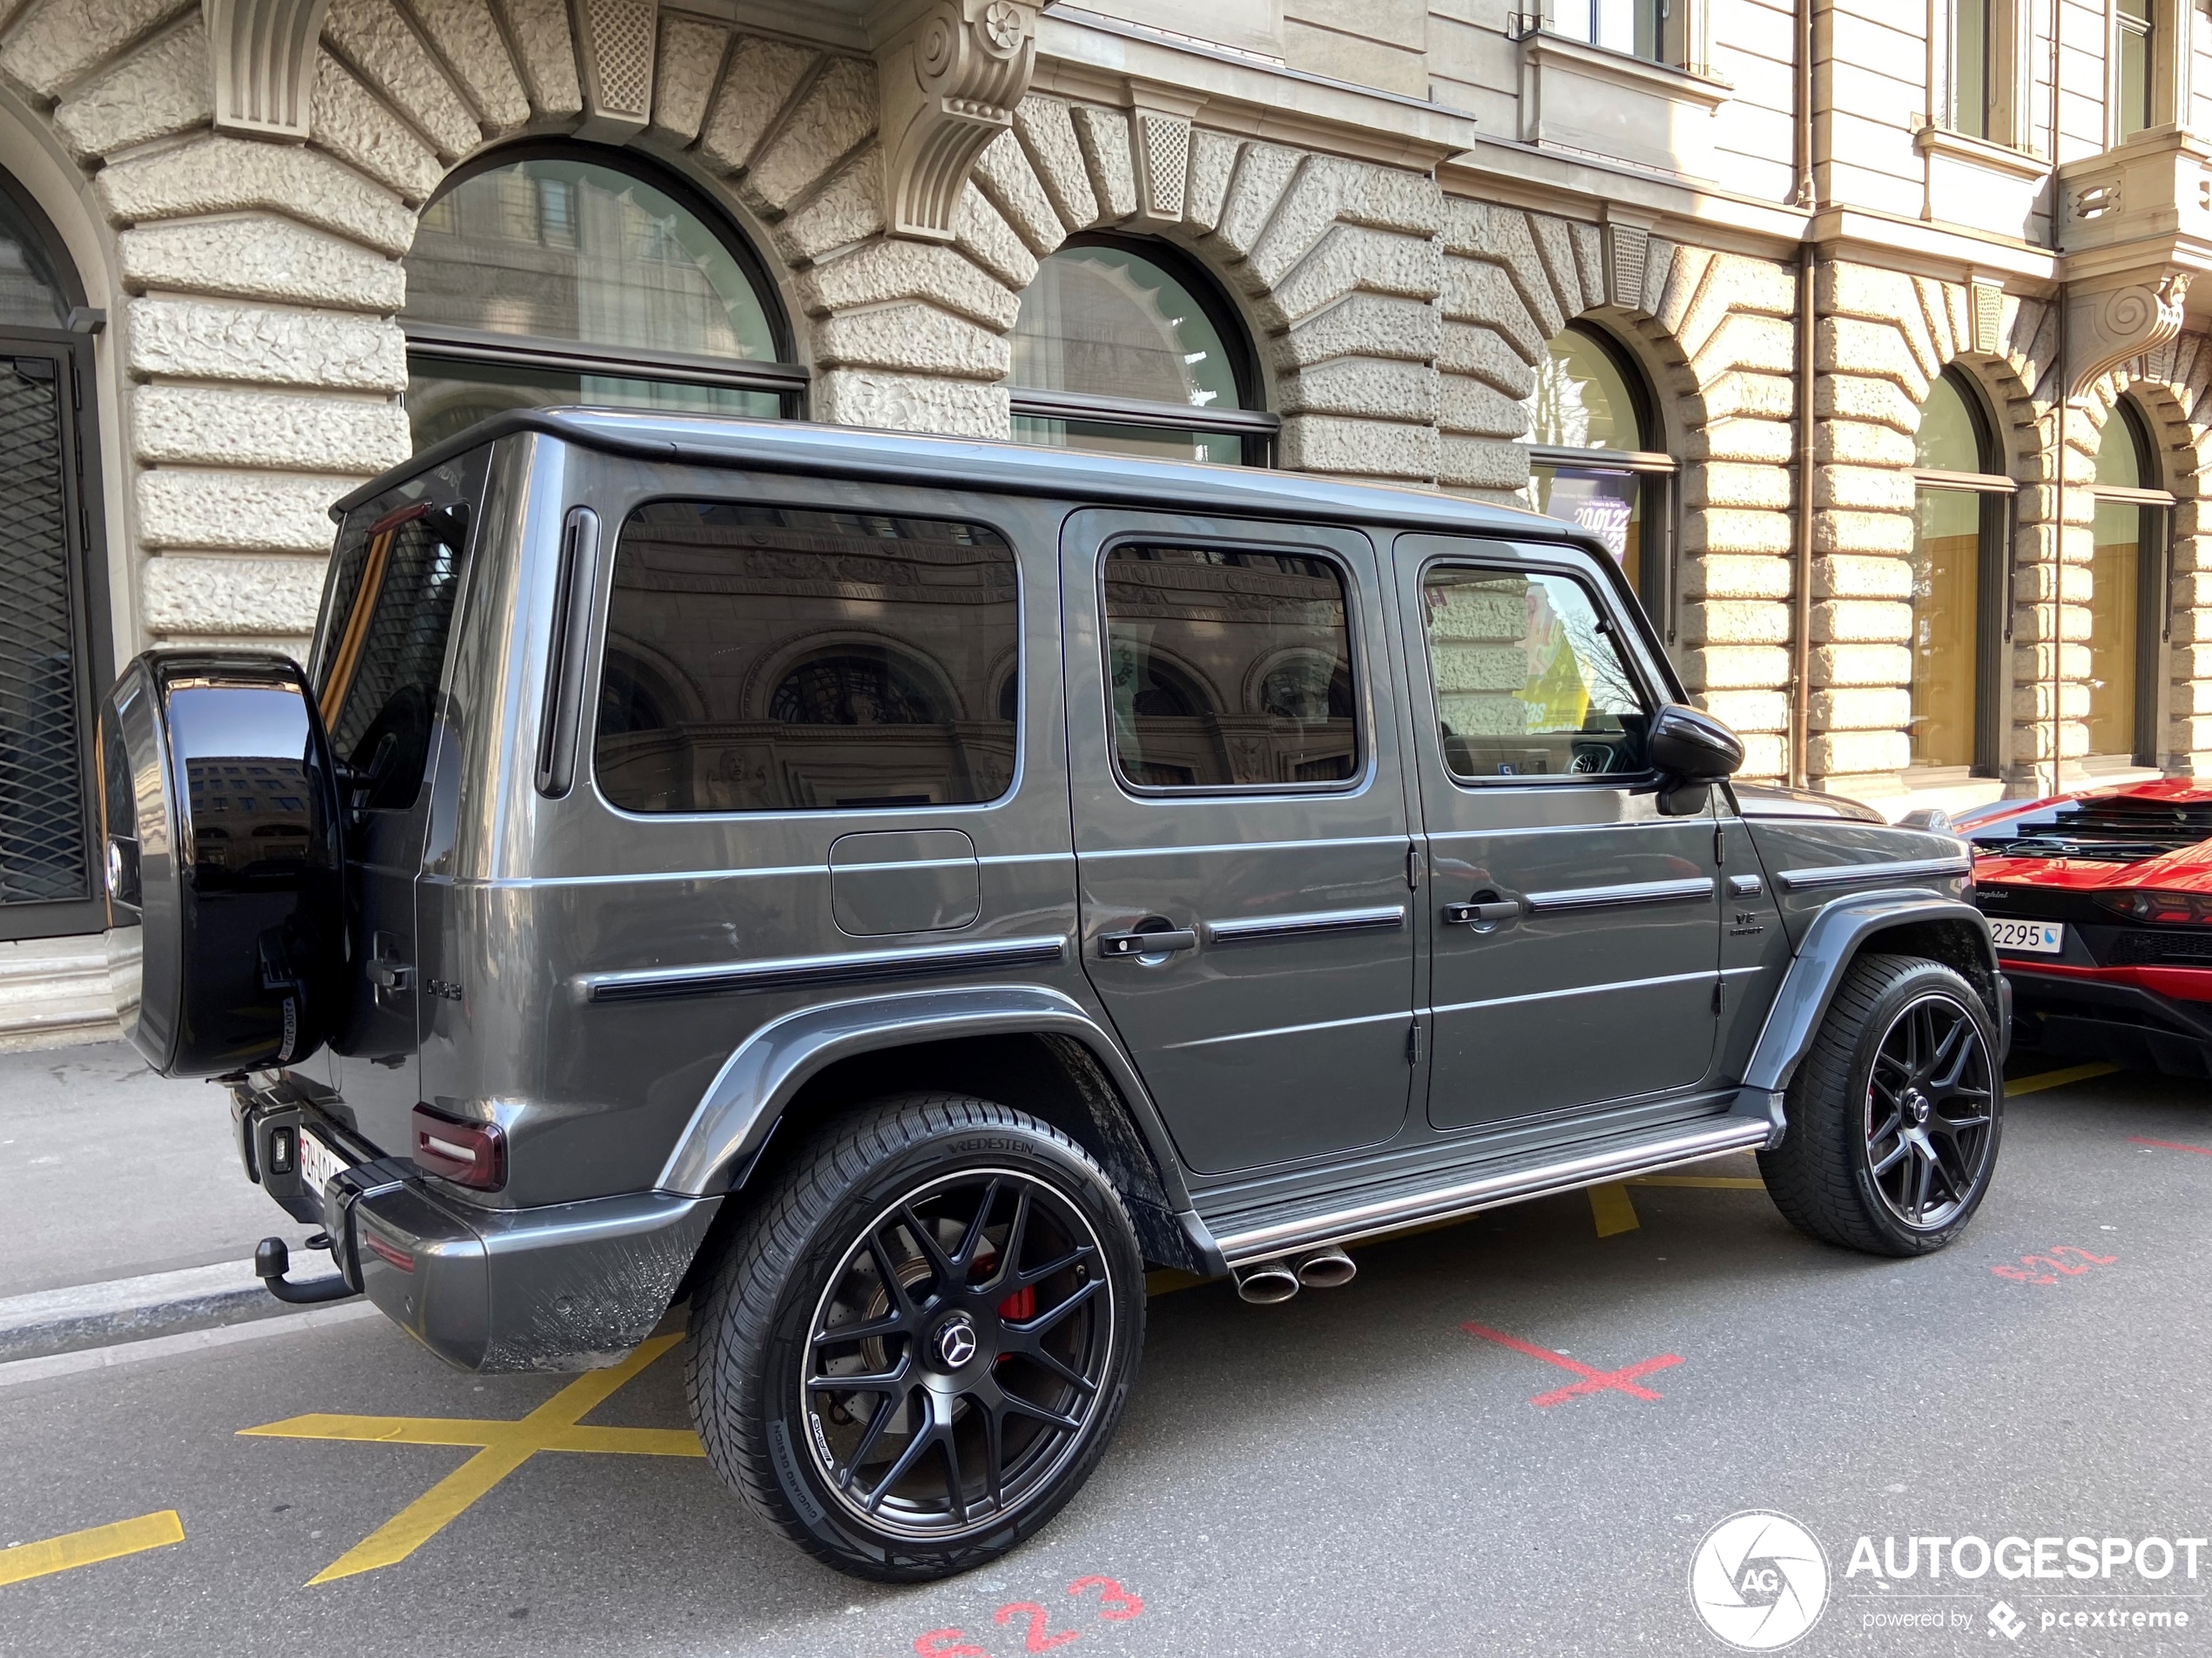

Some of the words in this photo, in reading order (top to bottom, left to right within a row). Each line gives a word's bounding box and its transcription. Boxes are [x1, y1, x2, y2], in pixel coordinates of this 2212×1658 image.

[1976, 889, 2009, 900] orghini
[1992, 923, 2040, 947] 2295
[947, 1137, 1034, 1155] VREDESTEIN
[774, 1424, 791, 1469] DESIGN
[786, 1471, 818, 1519] GIUGIARO
